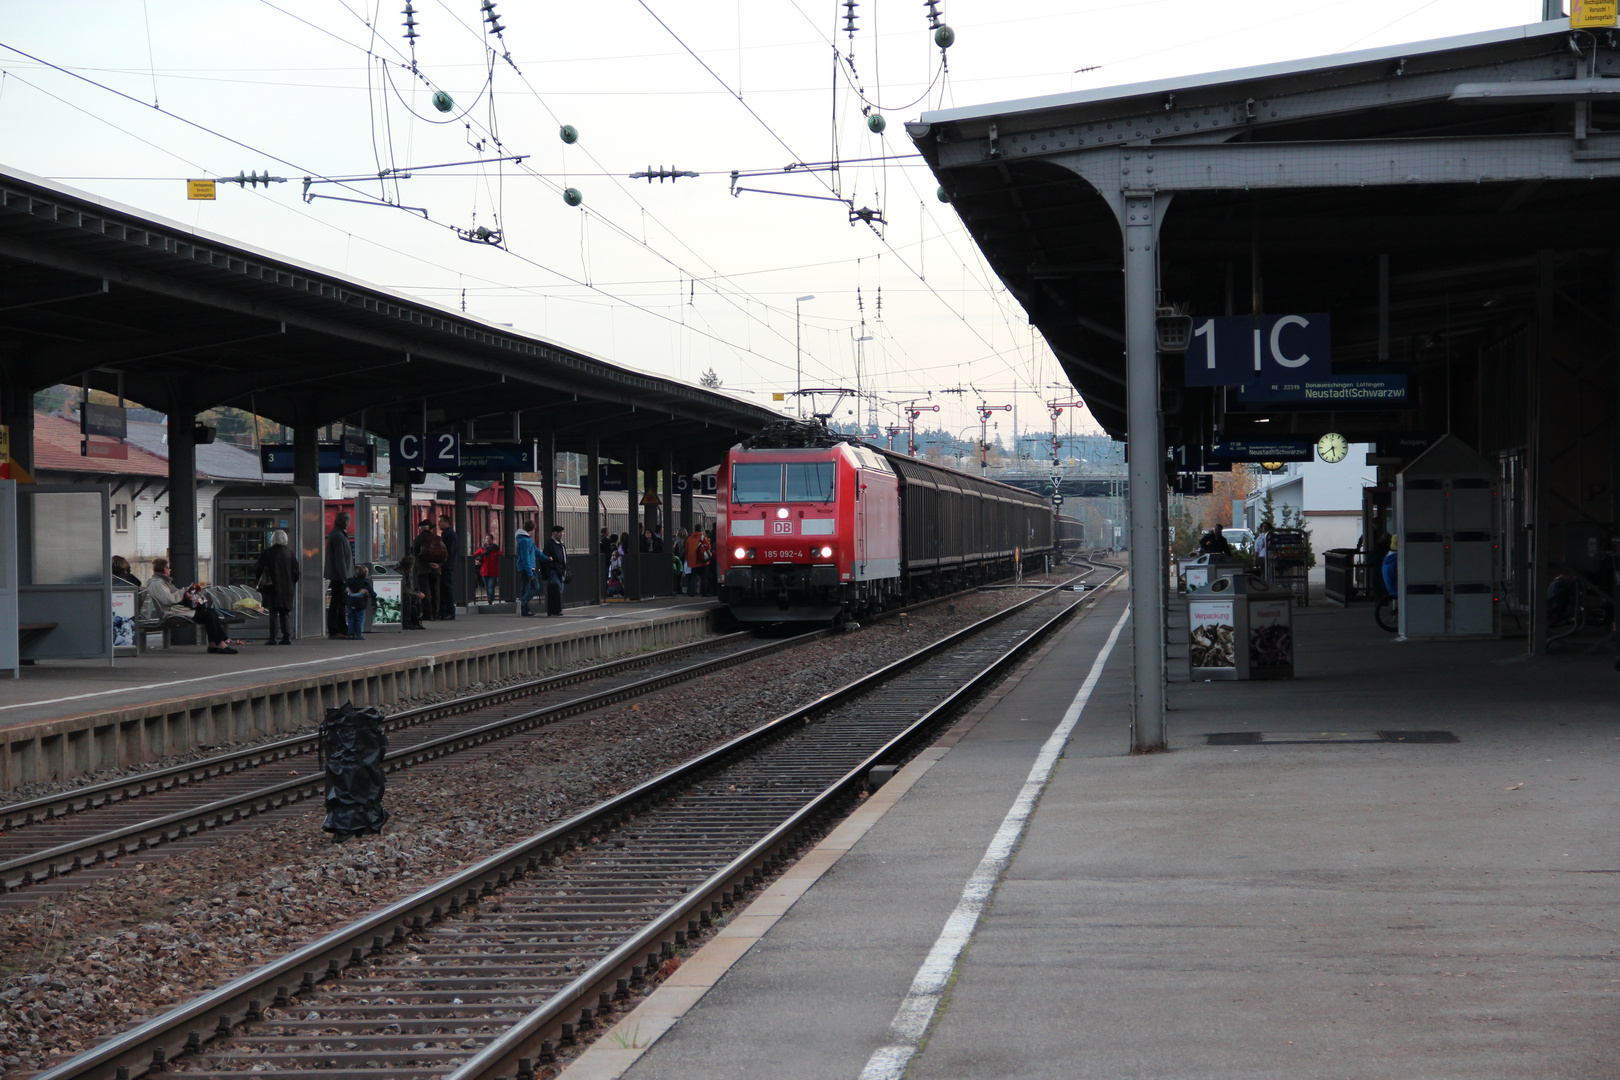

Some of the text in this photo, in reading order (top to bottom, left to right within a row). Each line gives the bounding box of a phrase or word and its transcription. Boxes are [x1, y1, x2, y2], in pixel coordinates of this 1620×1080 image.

[1194, 315, 1310, 369] 1 C
[1305, 387, 1405, 399] Neustadt(Schwarzw)
[400, 433, 455, 460] C 2
[268, 453, 274, 463] 3
[522, 452, 528, 462] 2
[1176, 445, 1186, 465] 1
[603, 465, 608, 476] 1
[677, 474, 717, 490] 5 D
[1054, 477, 1059, 485] 6
[1196, 476, 1206, 489] E
[775, 522, 791, 533] DB
[764, 550, 803, 558] 185 092-4
[1194, 612, 1230, 621] Verpackung
